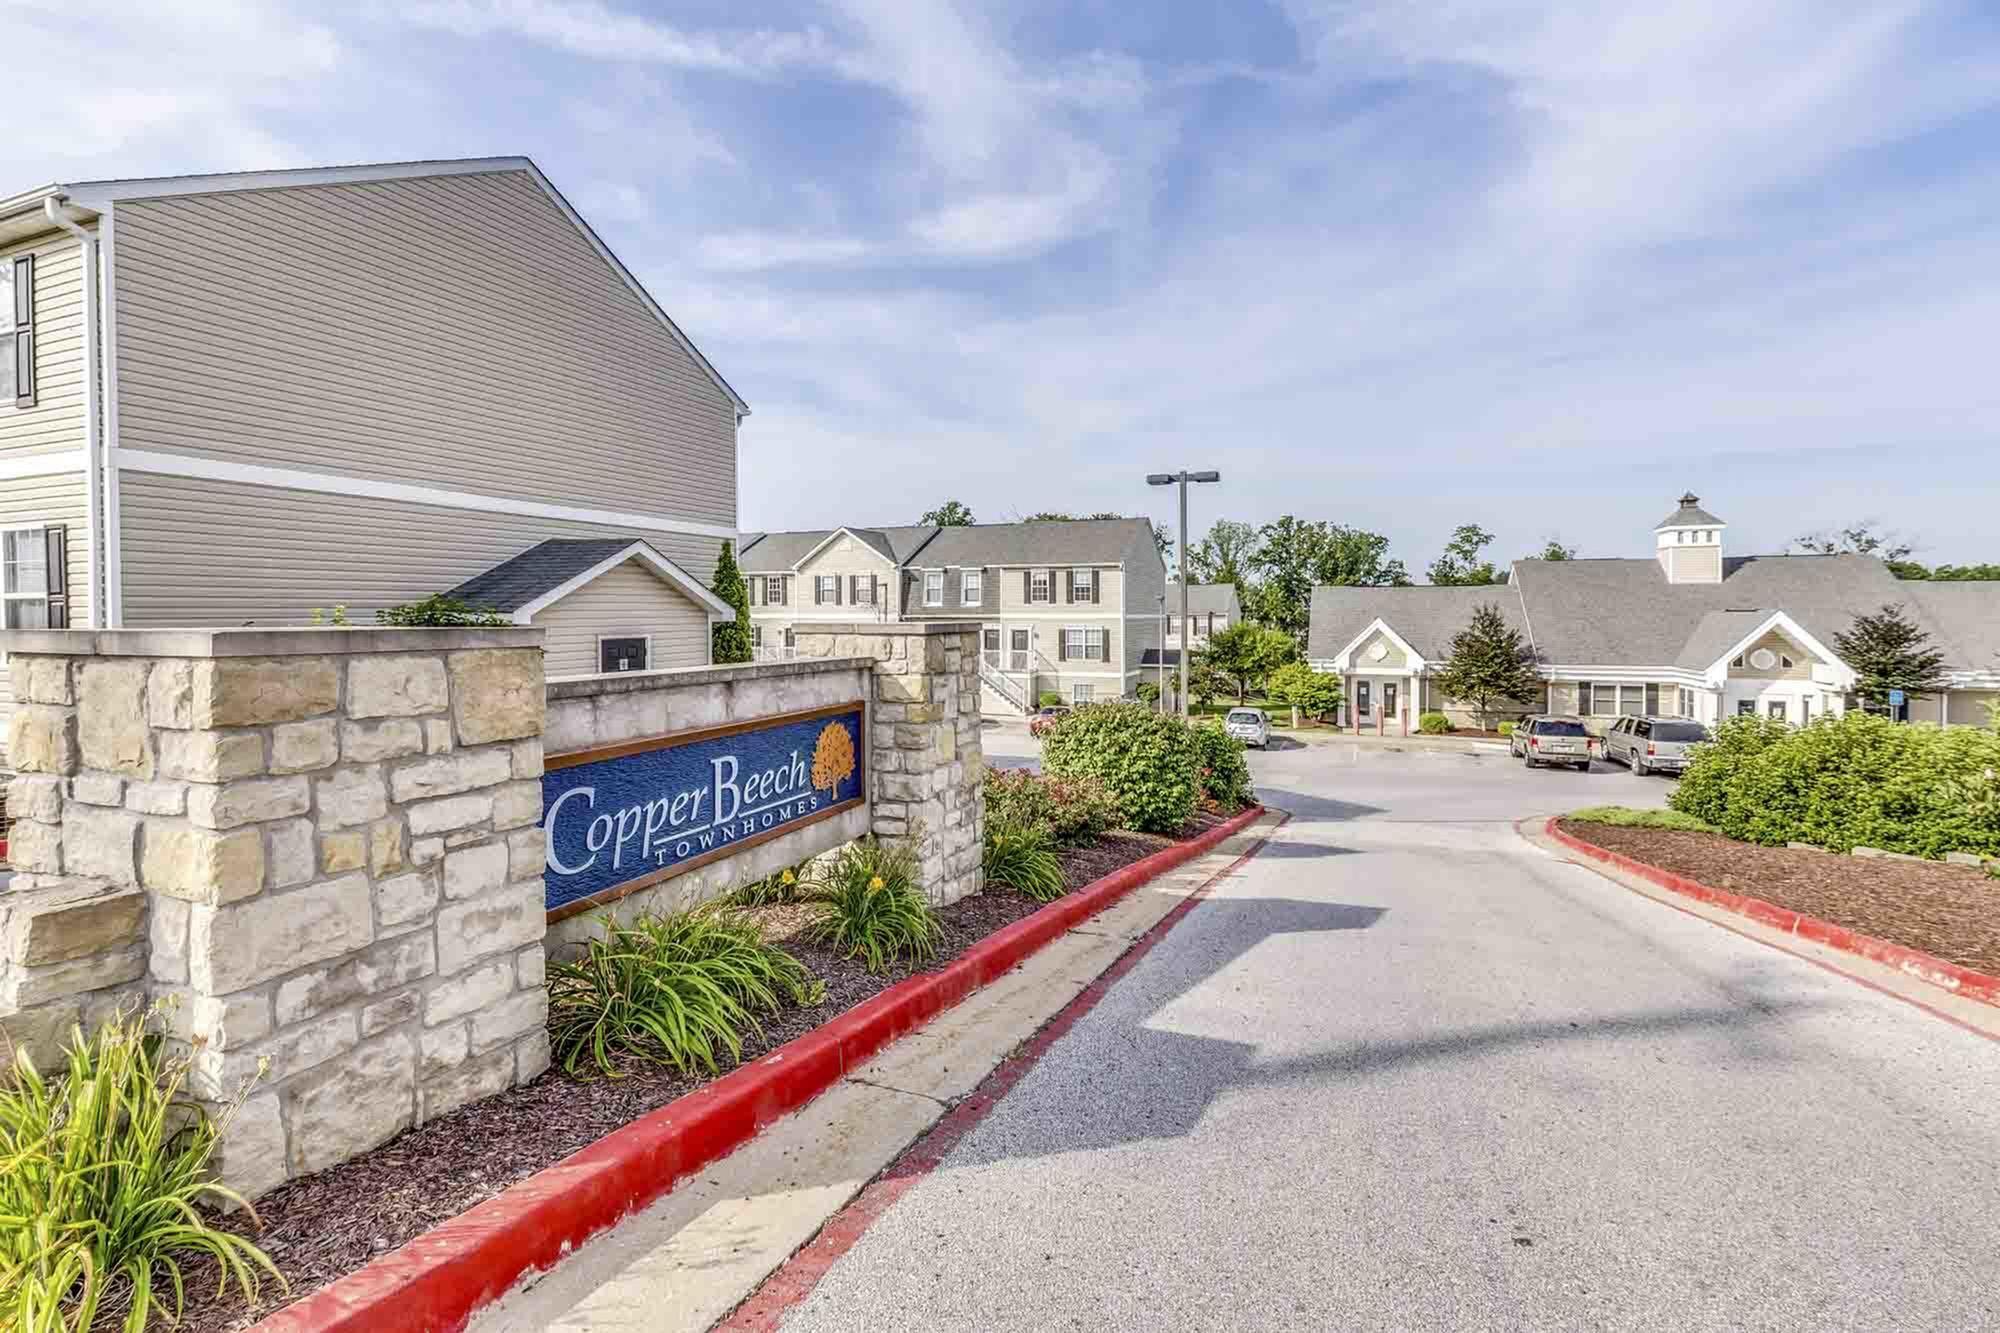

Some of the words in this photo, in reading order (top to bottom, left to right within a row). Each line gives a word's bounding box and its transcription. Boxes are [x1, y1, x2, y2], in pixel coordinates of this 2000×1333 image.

[545, 786, 709, 875] Copper
[710, 750, 807, 827] Beech
[654, 796, 818, 866] TOWNHOMES
